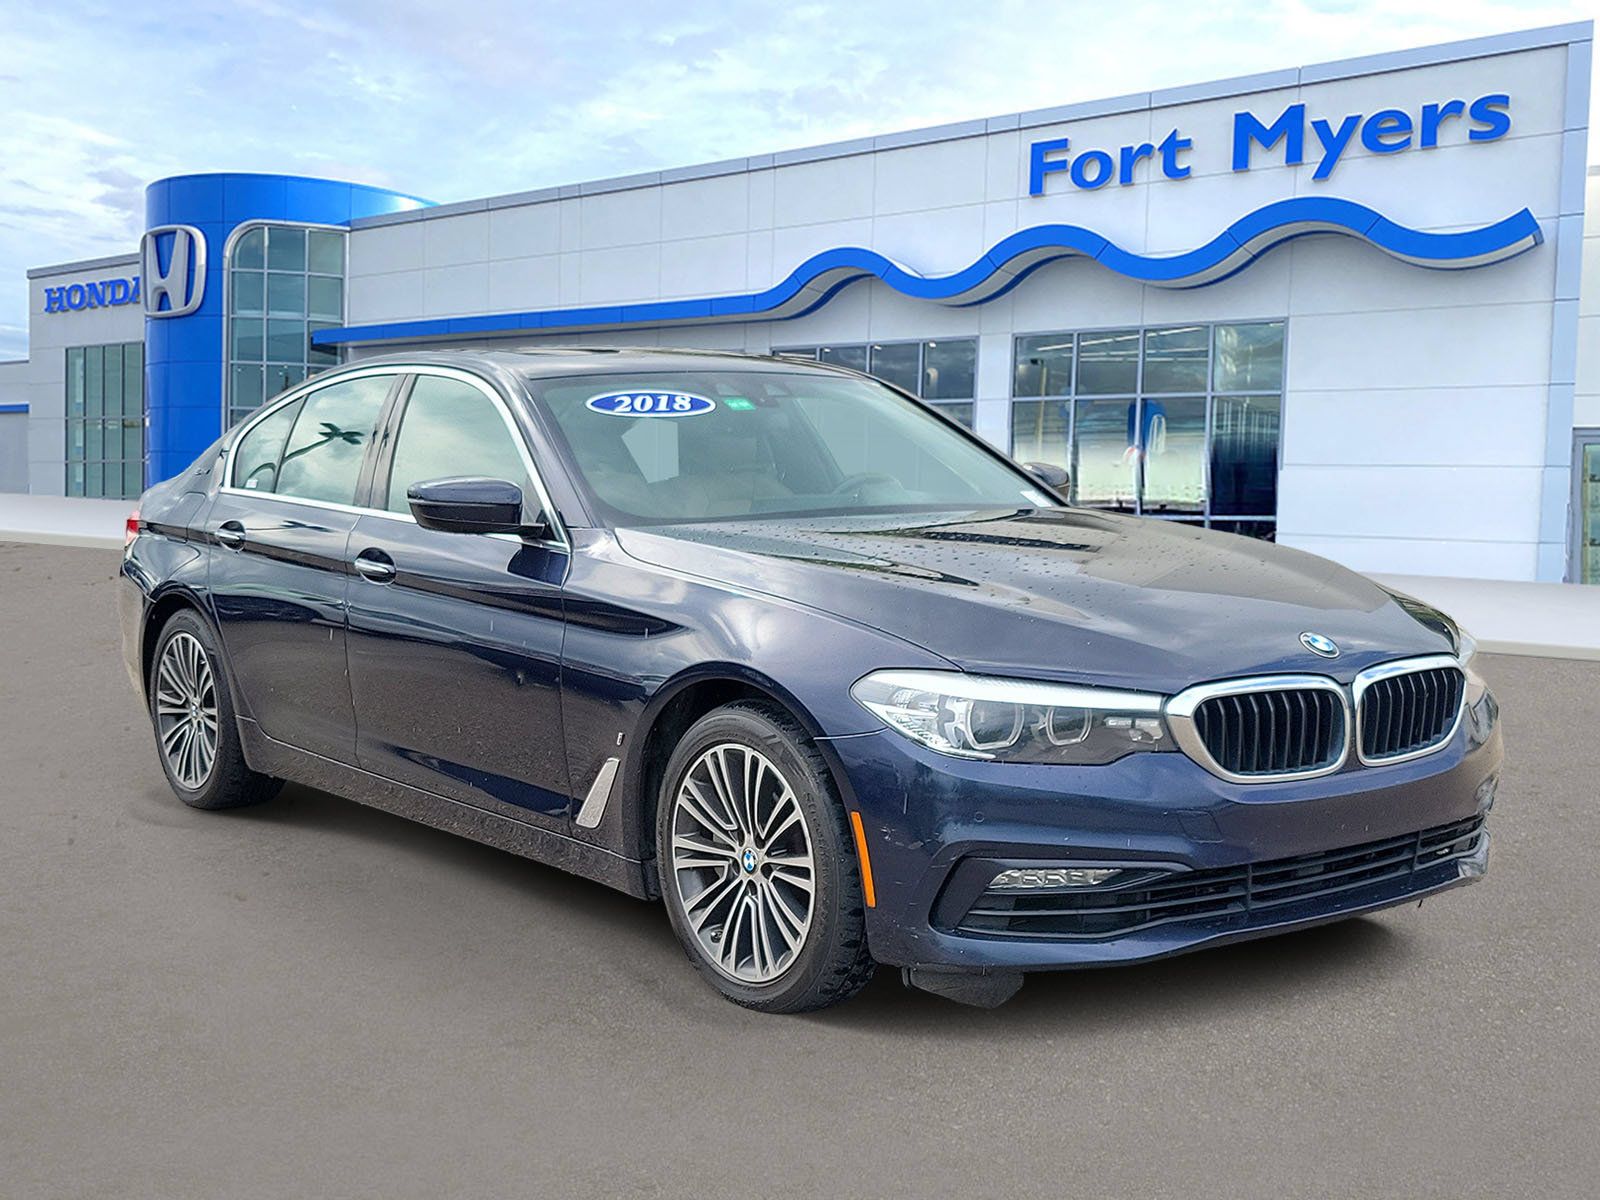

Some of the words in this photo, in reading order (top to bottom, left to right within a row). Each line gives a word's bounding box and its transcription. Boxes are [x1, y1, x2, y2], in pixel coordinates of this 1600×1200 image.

[1028, 128, 1193, 197] Fort
[1231, 93, 1512, 181] Myers
[613, 395, 693, 413] 2018
